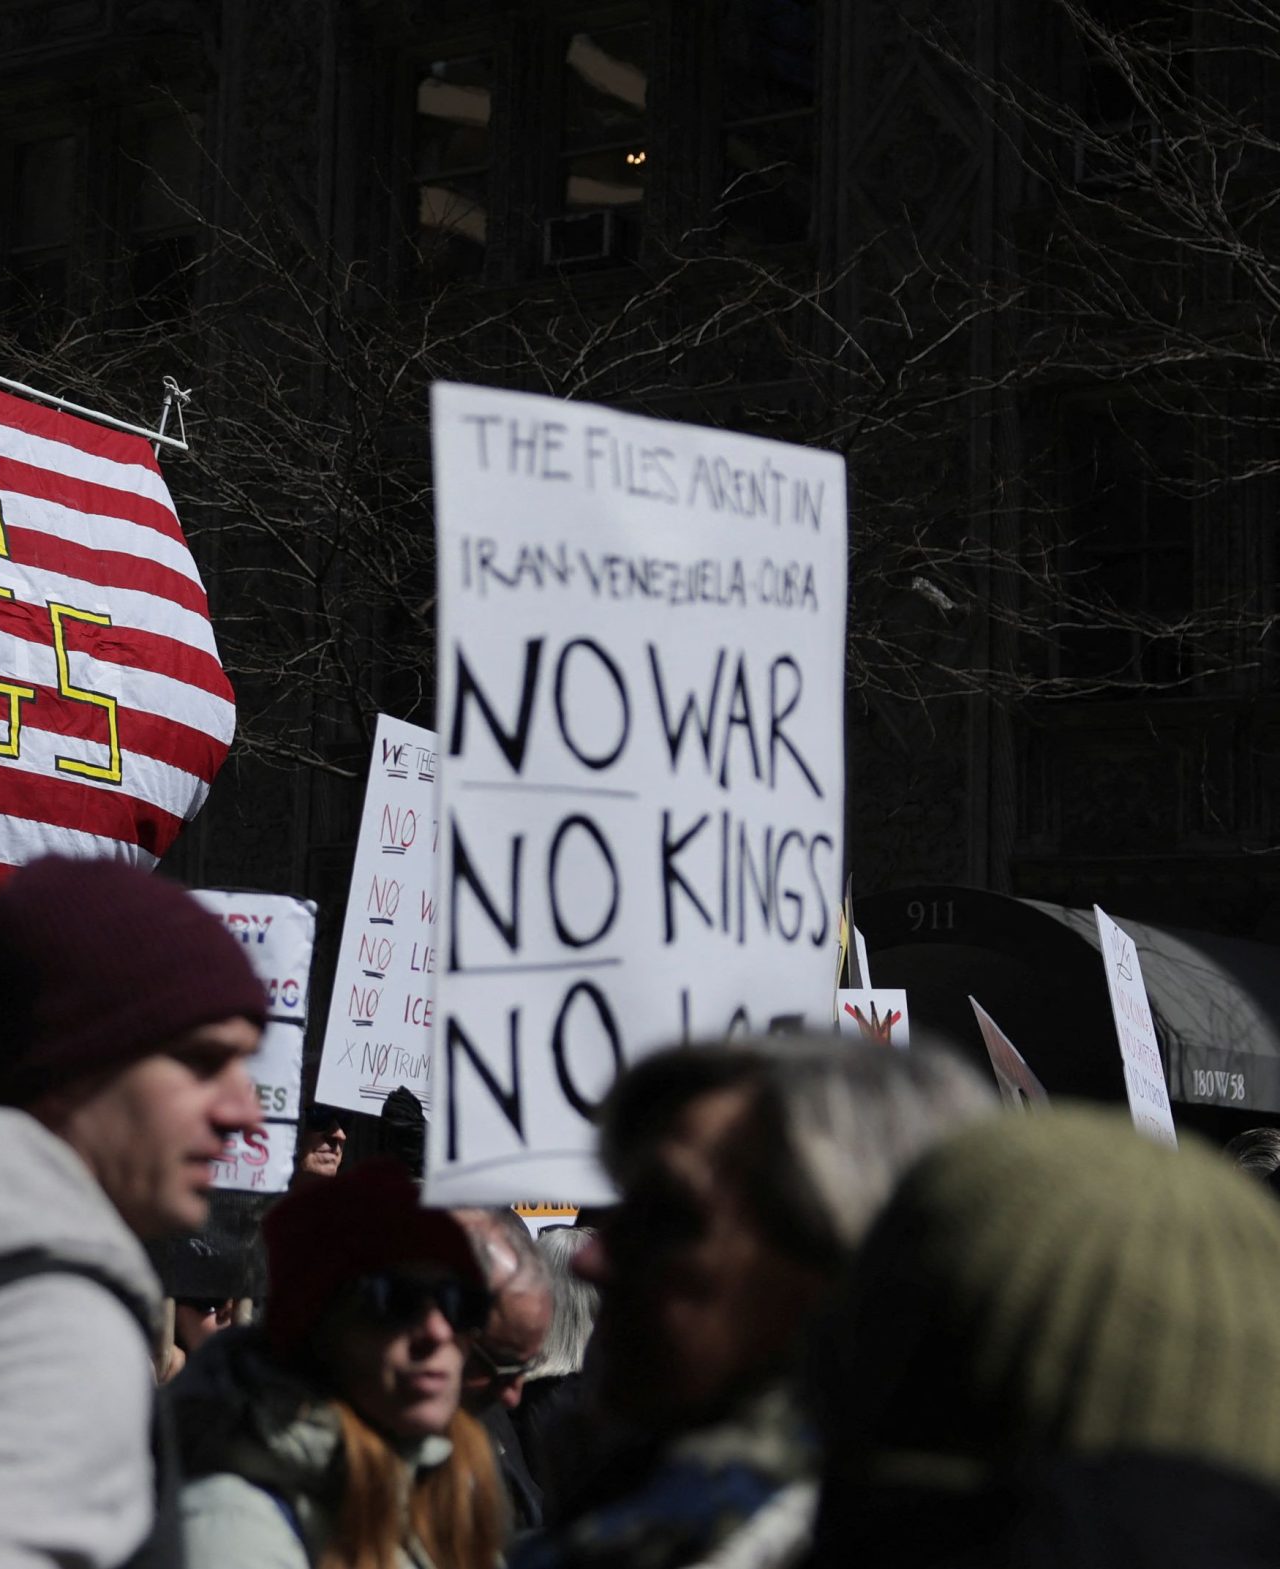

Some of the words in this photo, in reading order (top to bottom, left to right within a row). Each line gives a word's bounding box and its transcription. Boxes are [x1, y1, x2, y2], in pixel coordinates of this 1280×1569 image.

[461, 414, 572, 481] THE
[584, 426, 680, 505] FILES
[793, 478, 824, 531] IN
[382, 738, 413, 767] WE
[448, 634, 631, 775] NO
[648, 641, 823, 799] WAR
[449, 806, 620, 973] NO
[662, 809, 834, 948] KINGS
[907, 900, 955, 931] 911
[404, 993, 434, 1028] ICE
[393, 1046, 432, 1081] TRUM
[446, 980, 625, 1163] NO
